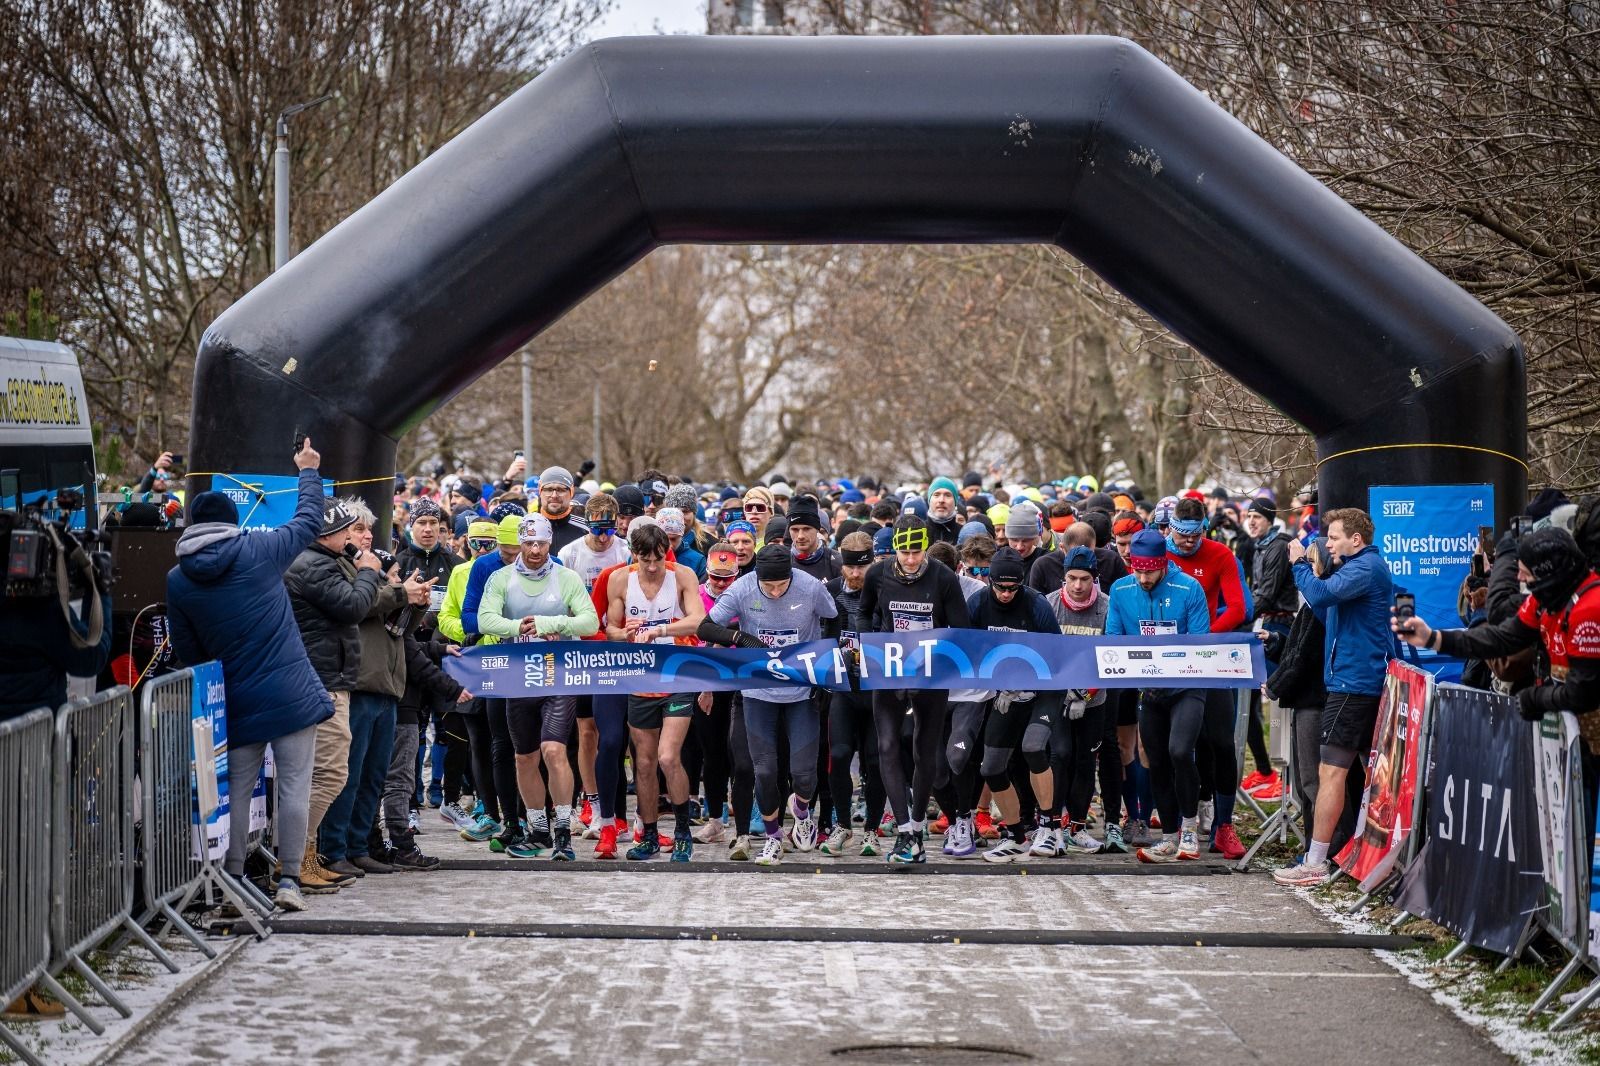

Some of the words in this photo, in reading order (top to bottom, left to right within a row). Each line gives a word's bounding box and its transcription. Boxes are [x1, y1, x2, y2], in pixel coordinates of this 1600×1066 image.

[1419, 557, 1431, 565] cez
[1431, 555, 1471, 565] bratislavské
[1419, 566, 1441, 577] mosty
[894, 619, 910, 631] 252
[564, 649, 656, 669] Silvestrovský
[766, 639, 939, 684] ŠTART
[524, 653, 544, 688] 2025
[598, 669, 609, 678] cez
[609, 667, 646, 677] bratislavské
[1104, 667, 1126, 675] OLO
[564, 670, 591, 686] beh
[598, 678, 618, 686] mosty
[1438, 774, 1516, 862] SITA
